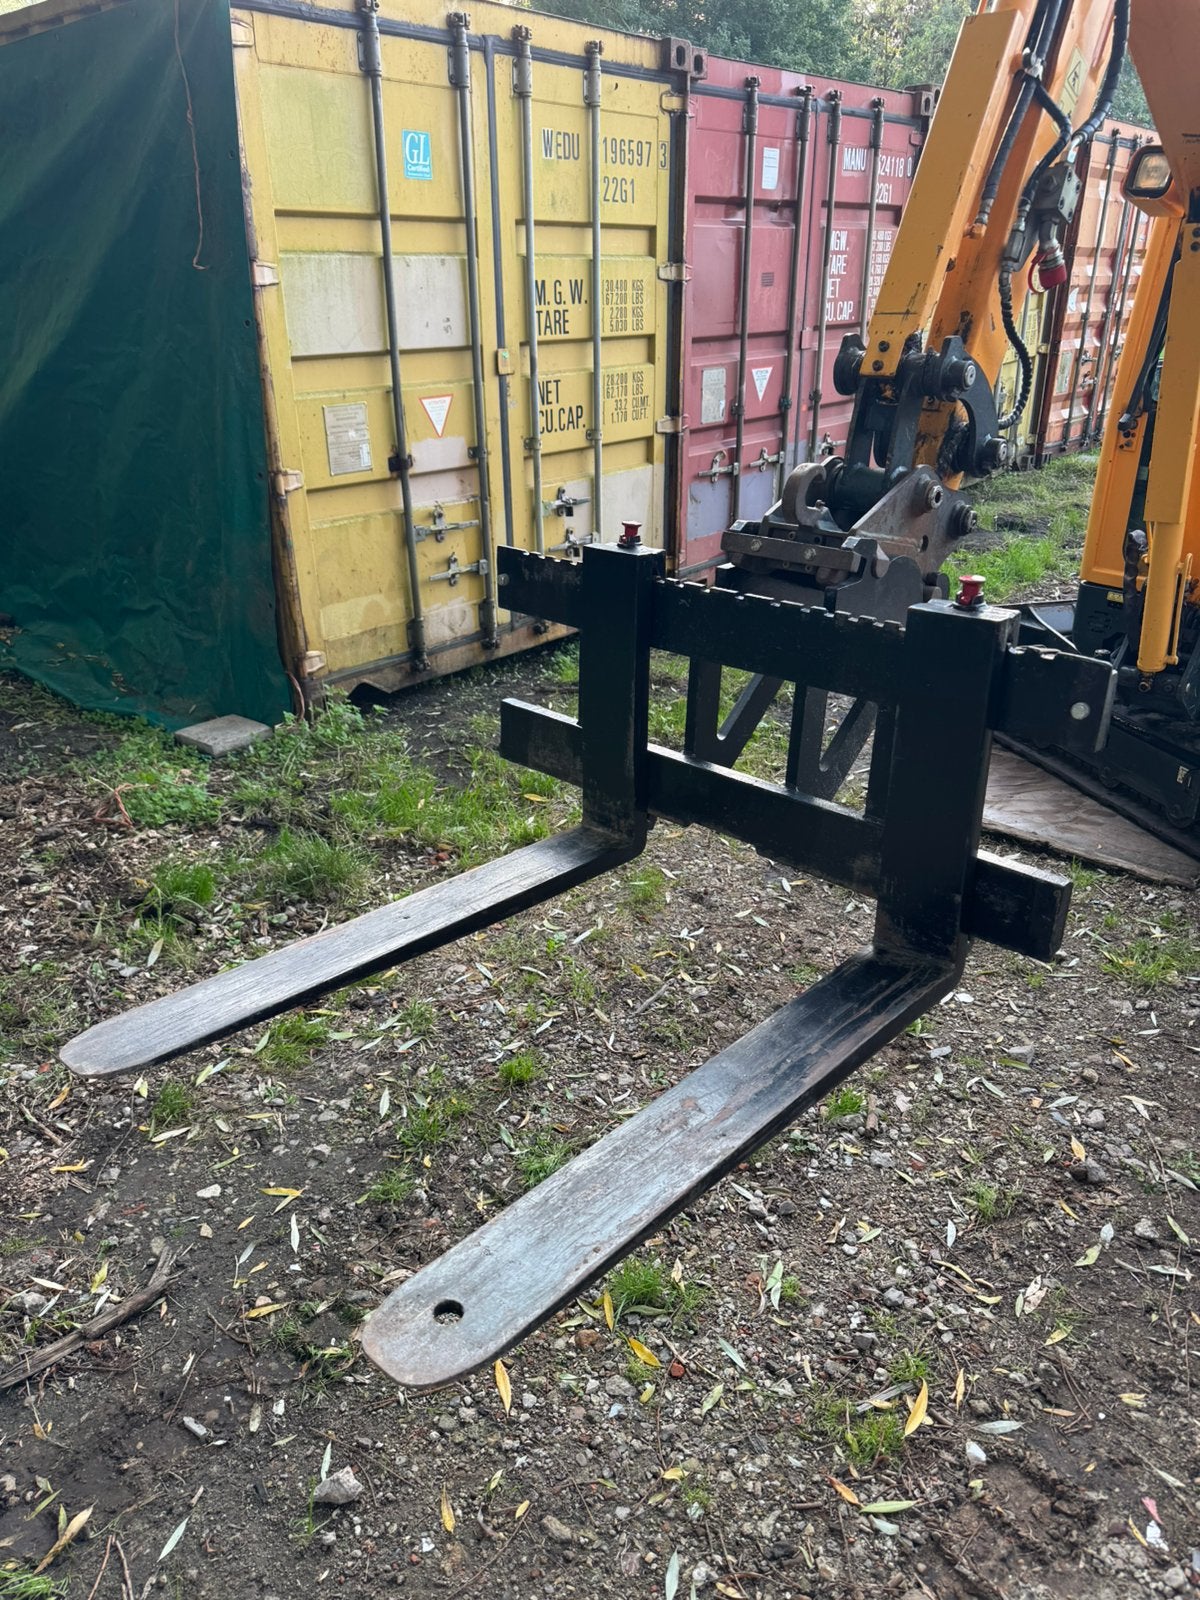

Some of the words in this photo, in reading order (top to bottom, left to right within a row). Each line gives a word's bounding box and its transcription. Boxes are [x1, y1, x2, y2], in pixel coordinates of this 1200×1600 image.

[405, 132, 430, 165] GL
[542, 128, 580, 161] WEDU
[602, 136, 652, 167] 196597
[660, 142, 668, 168] 3
[843, 147, 867, 171] MANU
[603, 175, 635, 204] 22G1
[631, 279, 644, 292] KGS
[631, 292, 644, 305] LBS
[631, 306, 644, 319] KGS
[536, 309, 570, 336] TARE
[631, 319, 644, 332] LBS
[631, 383, 644, 396] LBS
